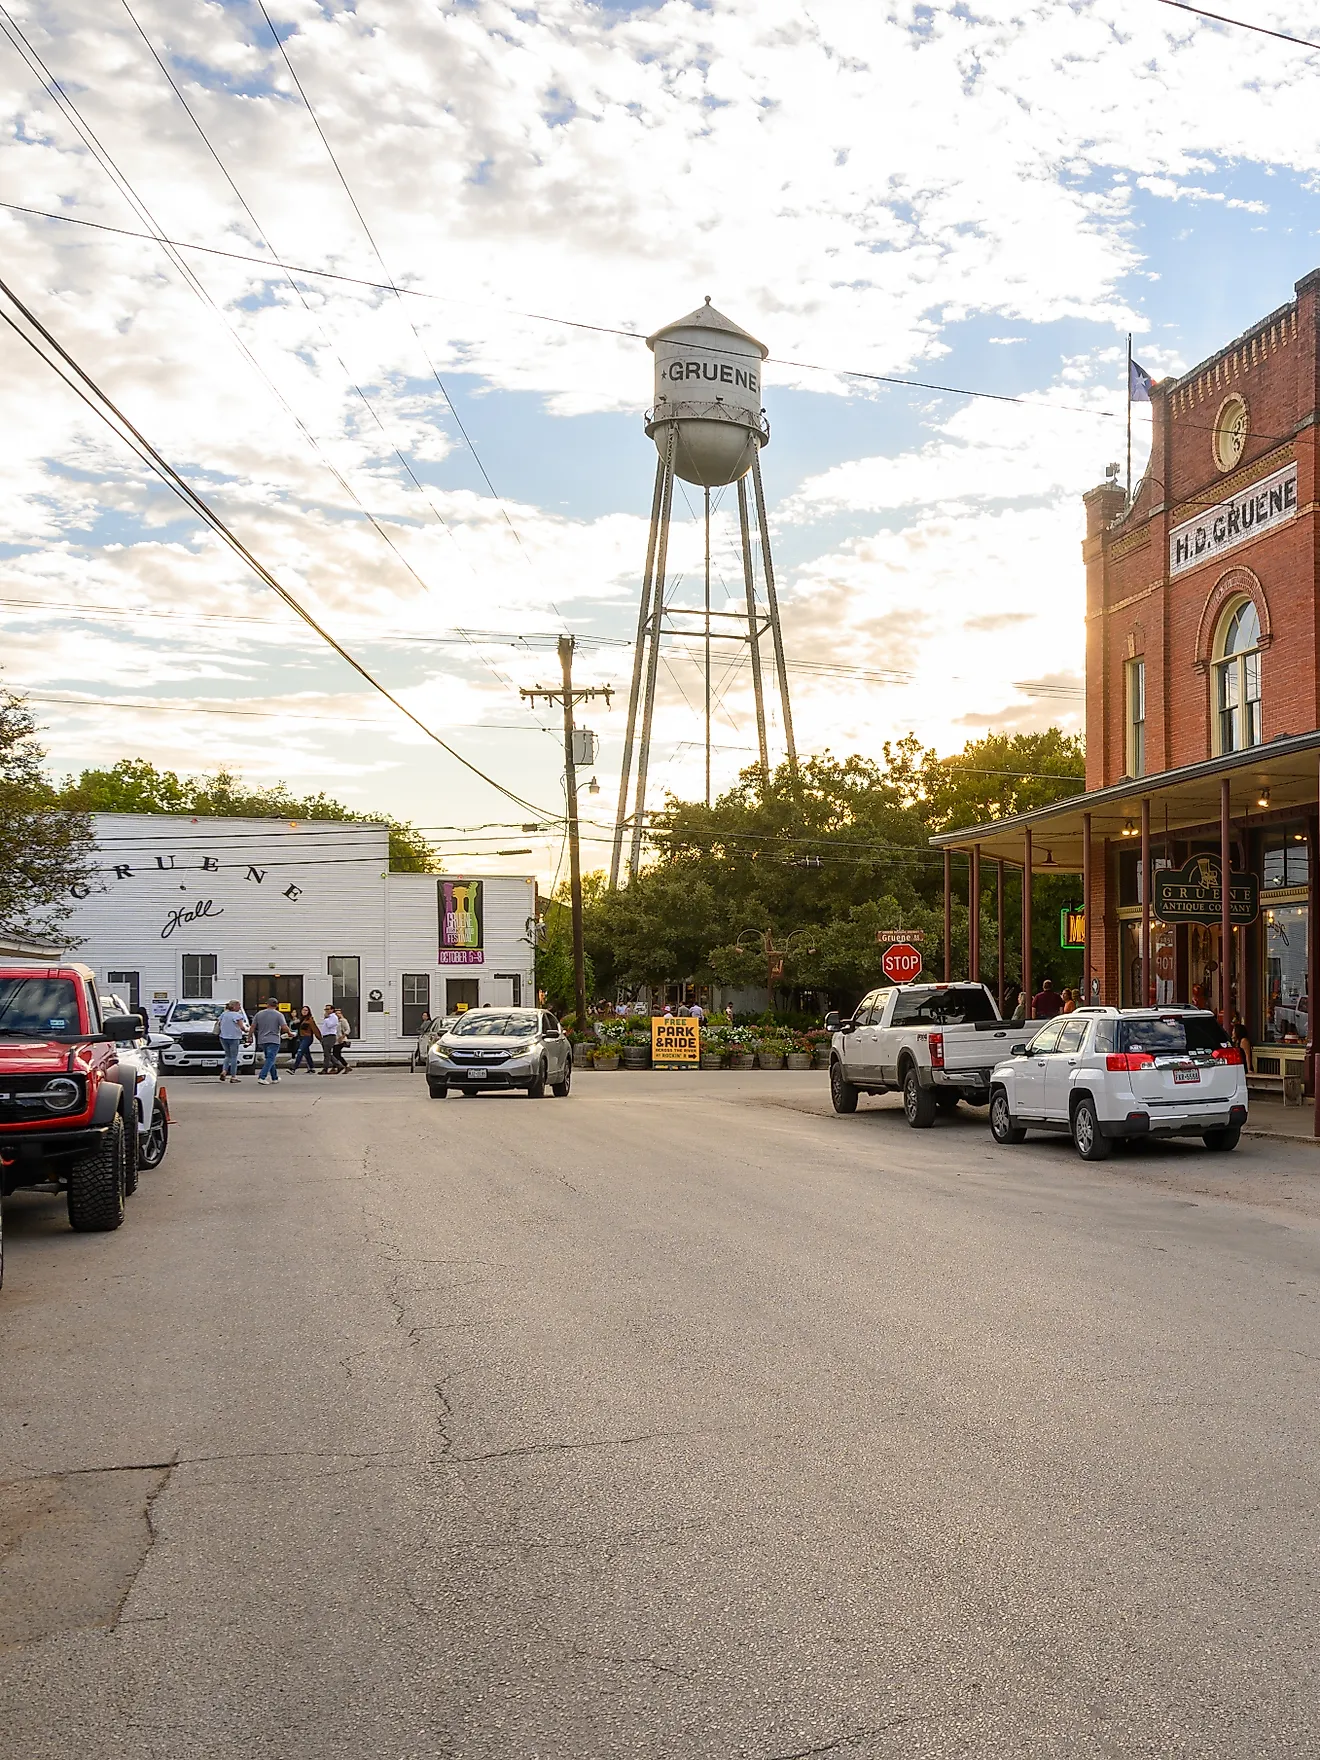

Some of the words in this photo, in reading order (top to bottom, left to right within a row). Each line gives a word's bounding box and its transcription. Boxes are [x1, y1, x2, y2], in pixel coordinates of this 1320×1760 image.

[669, 362, 757, 393] GRUENE
[1212, 477, 1297, 543] GRUENE
[70, 855, 303, 902] GRUENE
[1162, 887, 1251, 900] GRUENE
[1162, 902, 1205, 912] ANTIQUE
[1208, 903, 1251, 912] COPANY
[161, 900, 224, 938] Hall
[447, 912, 473, 928] GRUENE
[447, 933, 473, 943] FESTIVAL
[440, 951, 467, 963] OCTOBER
[886, 956, 919, 971] STOP
[657, 1026, 695, 1037] PARK
[656, 1038, 696, 1048] &RIDE
